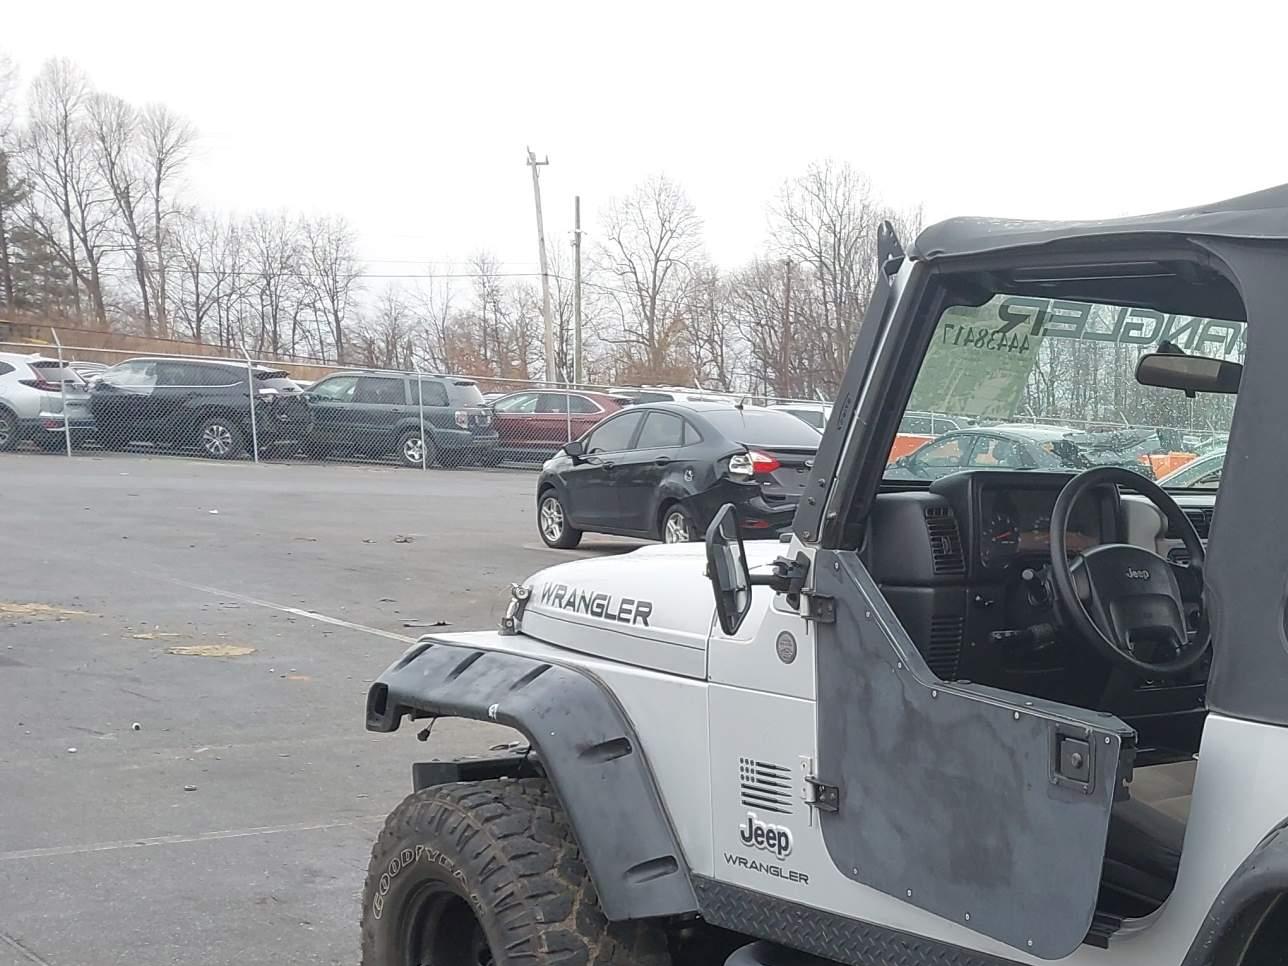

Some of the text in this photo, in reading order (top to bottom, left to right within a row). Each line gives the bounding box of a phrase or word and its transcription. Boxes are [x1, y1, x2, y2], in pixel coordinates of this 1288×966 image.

[1125, 567, 1150, 581] Jeep
[540, 581, 653, 627] WRANGLER
[740, 815, 791, 857] Jeep
[724, 852, 809, 885] WRANGLER
